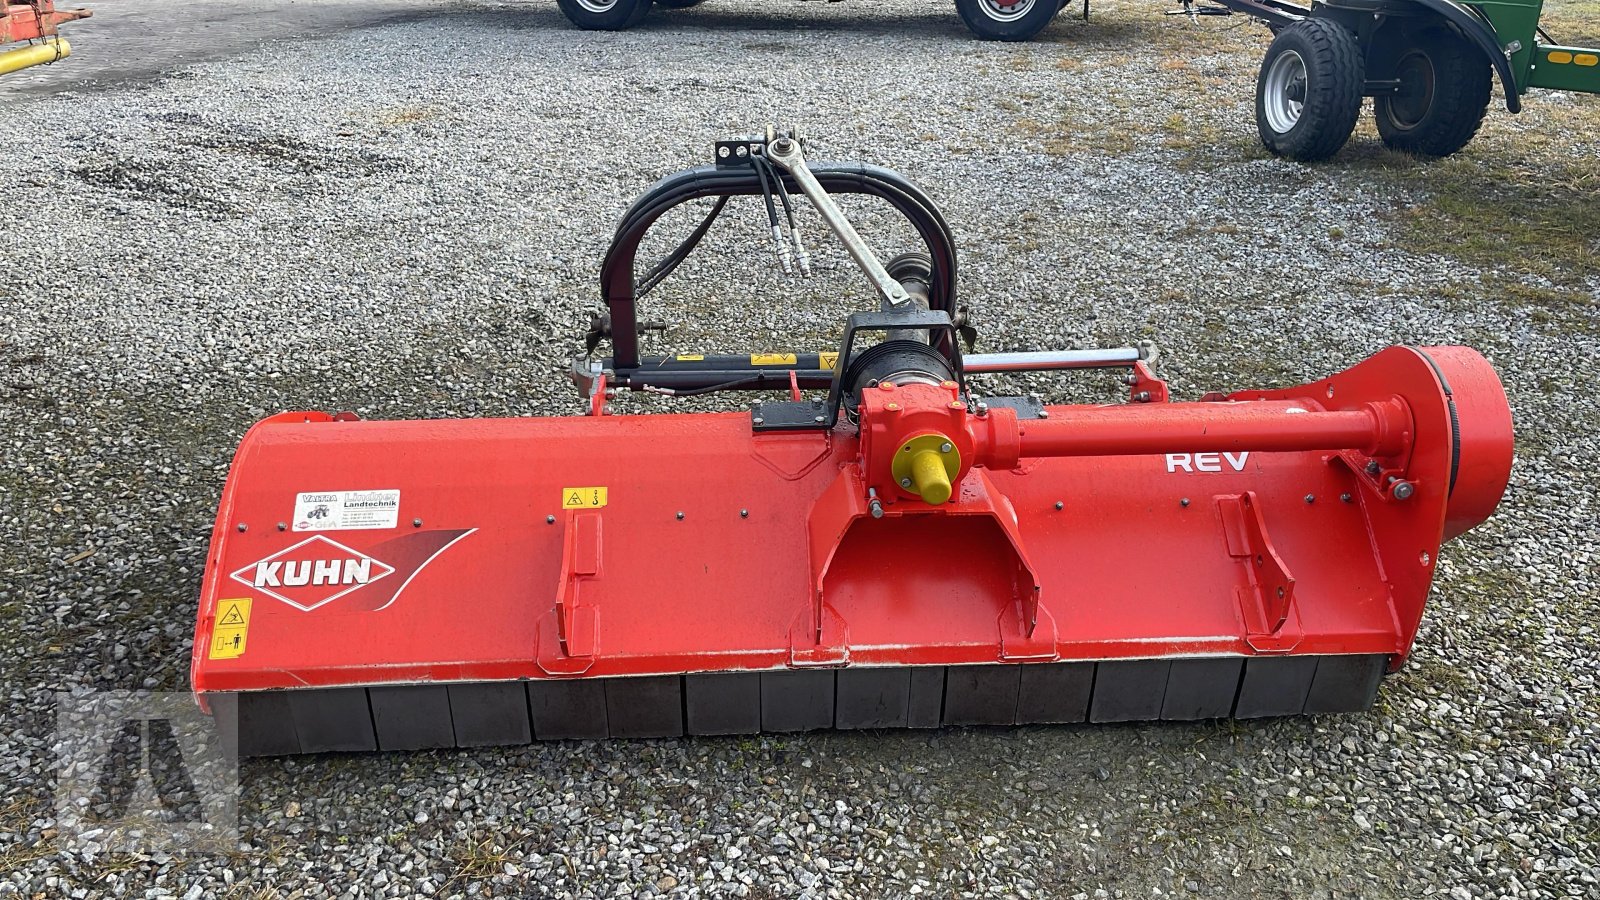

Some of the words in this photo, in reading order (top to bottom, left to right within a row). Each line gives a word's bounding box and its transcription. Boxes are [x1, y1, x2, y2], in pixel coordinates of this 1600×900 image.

[1166, 451, 1250, 473] REV
[303, 495, 338, 503] VALTRA
[344, 492, 398, 502] Lindner
[253, 558, 371, 588] KUHN
